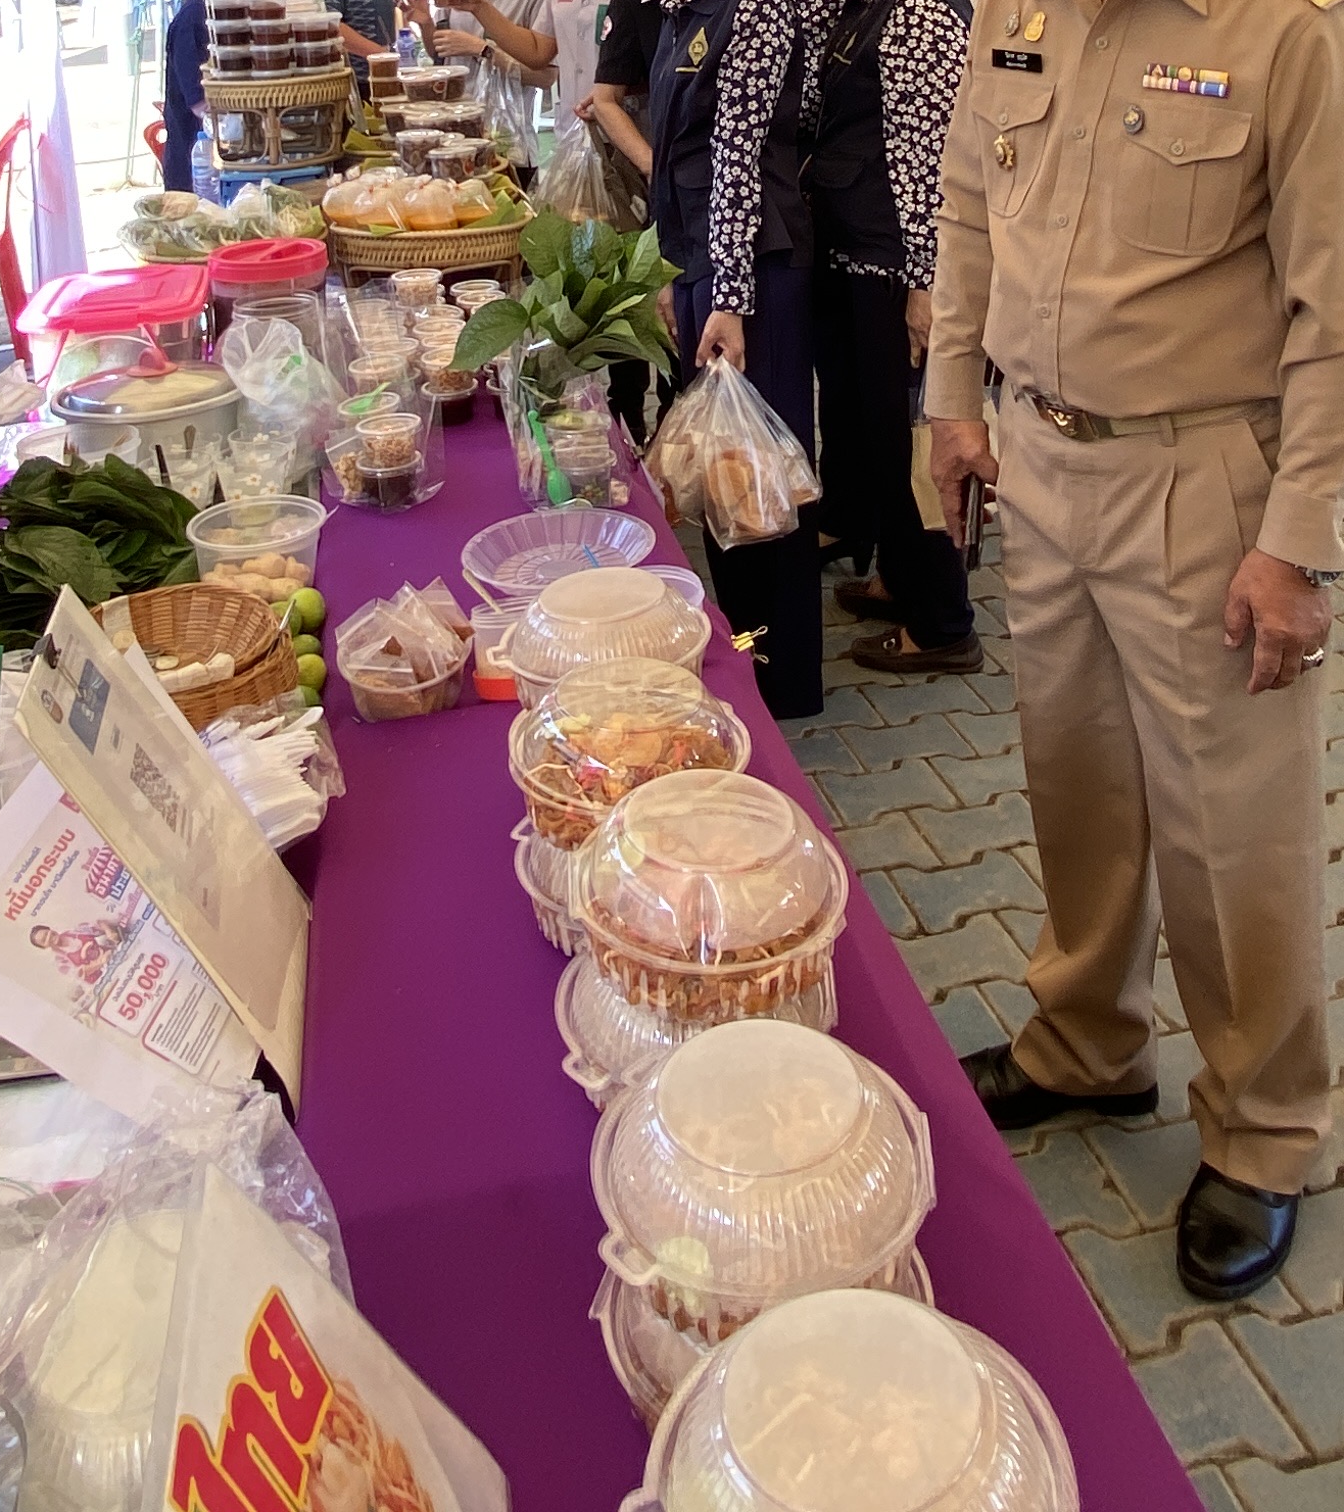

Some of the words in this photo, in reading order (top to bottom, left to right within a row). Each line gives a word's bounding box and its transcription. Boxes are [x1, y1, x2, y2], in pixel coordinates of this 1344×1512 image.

[3, 827, 76, 921] หนี้นอกระบบ
[118, 952, 169, 1022] 50,000
